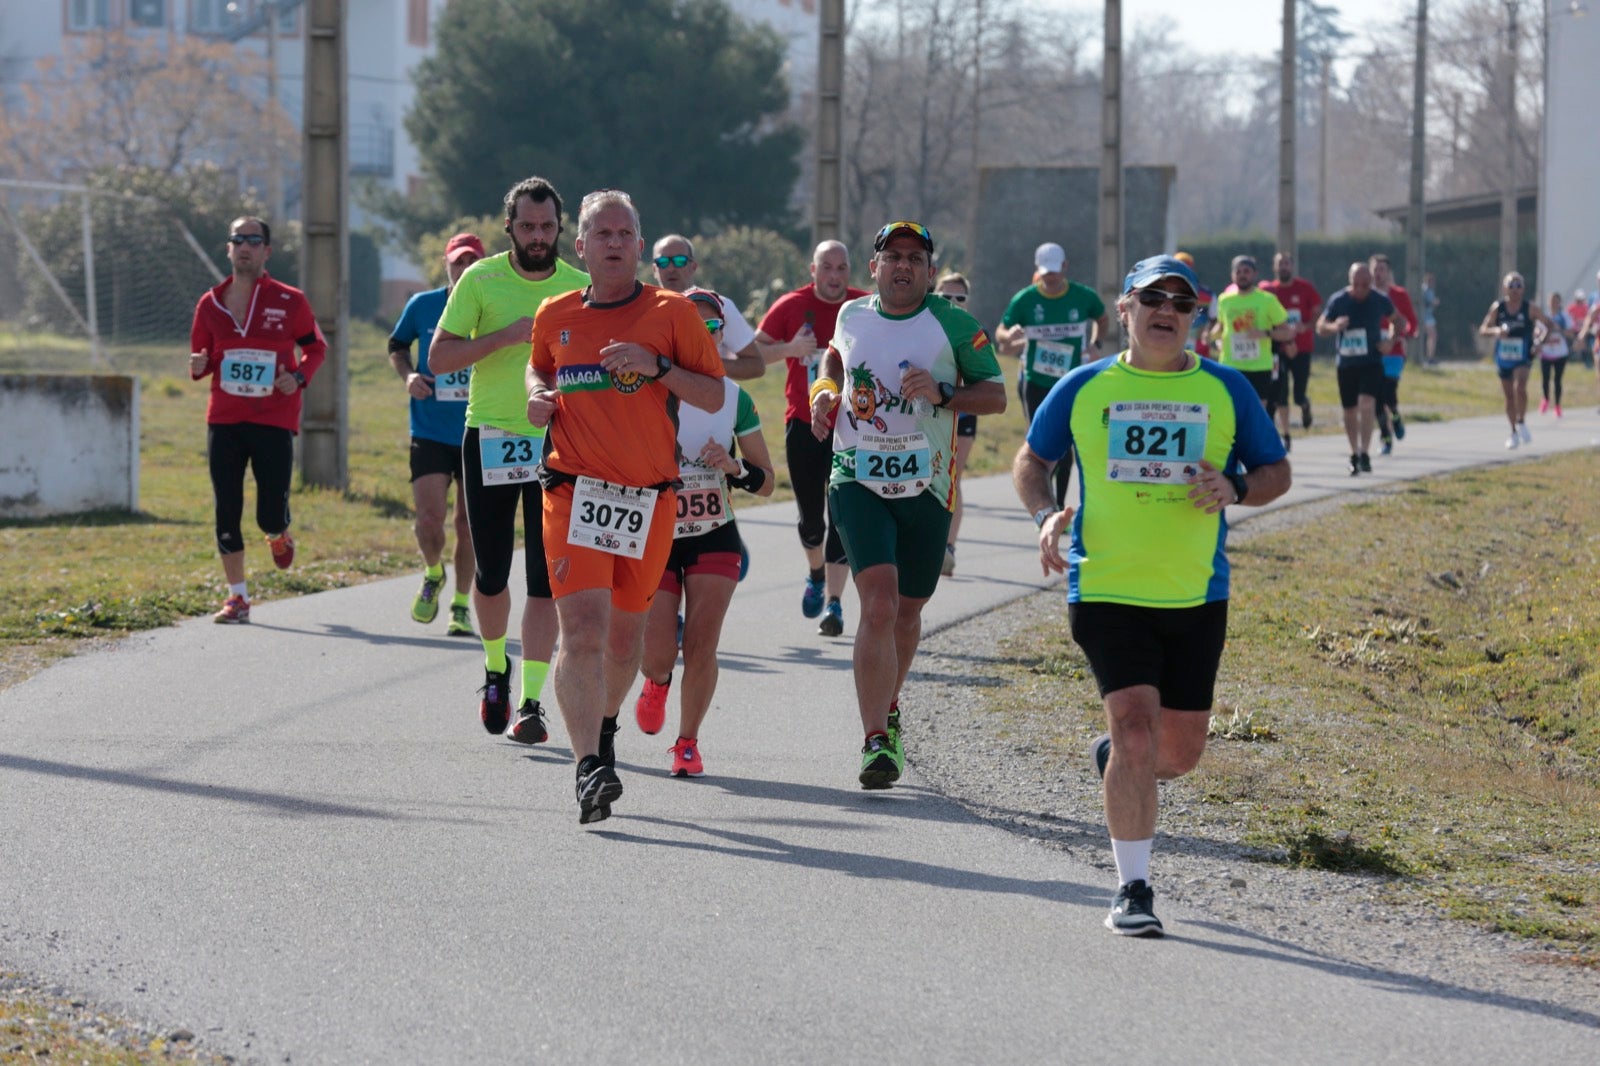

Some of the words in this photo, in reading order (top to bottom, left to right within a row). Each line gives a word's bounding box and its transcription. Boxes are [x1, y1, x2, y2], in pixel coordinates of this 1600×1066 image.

[1041, 351, 1066, 366] 696
[231, 363, 266, 381] 587
[557, 369, 603, 387] MÁLAGA
[613, 374, 645, 393] RUNNERS
[502, 439, 533, 464] 23
[1125, 425, 1187, 457] 821
[868, 453, 919, 478] 264
[580, 500, 643, 534] 3079
